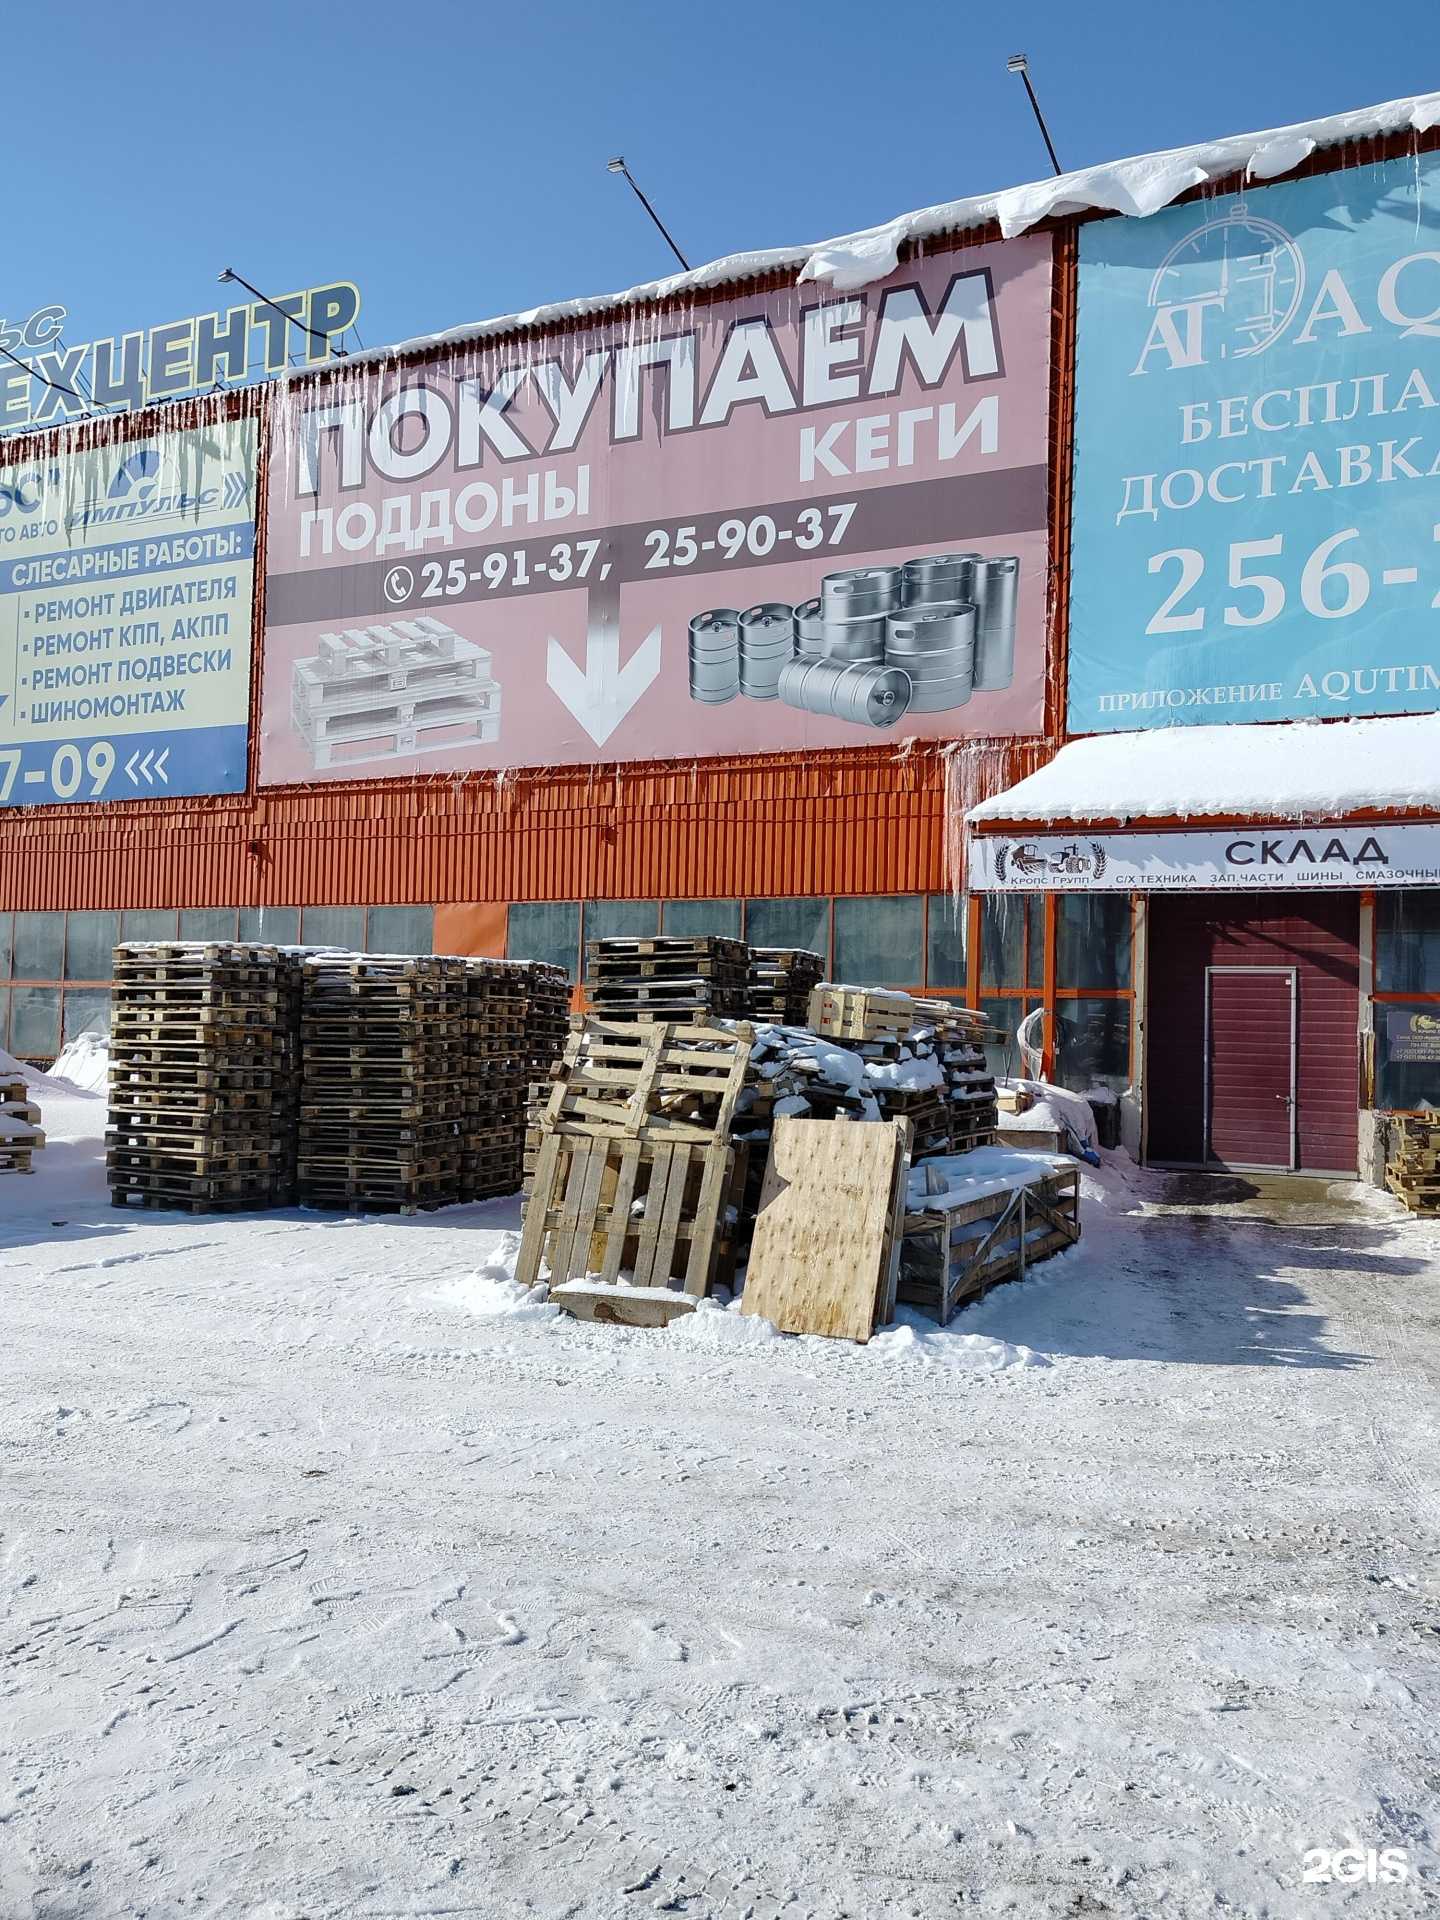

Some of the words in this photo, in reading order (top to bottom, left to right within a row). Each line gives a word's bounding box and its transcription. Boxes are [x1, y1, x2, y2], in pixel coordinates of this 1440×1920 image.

[0, 281, 361, 430] ЕХЦЕНТР
[294, 267, 1006, 497] ПОКУПАЕМ
[1179, 368, 1439, 445] БЕСПЛА
[799, 395, 999, 482] КЕГИ
[19, 519, 58, 541] АВТО
[300, 464, 590, 557] ПОДДОНЫ
[12, 545, 139, 586] СЛЕСАРНЫЕ
[145, 531, 242, 568] РАБОТЫ:
[421, 539, 613, 599] 25-91-37,
[644, 503, 858, 569] 25-90-37
[35, 593, 115, 623] РЕМОНТ
[119, 576, 237, 616] ДВИГАТЕЛЯ
[1144, 527, 1440, 635] 256-
[33, 628, 114, 657] РЕМОНТ
[119, 622, 165, 649] КПП,
[171, 613, 229, 641] АКПП
[32, 662, 112, 690] РЕМОНТ
[117, 649, 232, 682] ПОДВЕСКИ
[1098, 682, 1282, 712] ПРИЛОЖЕНИЕ
[30, 689, 186, 724] ШИНОМОНТАЖ
[0, 741, 116, 800] 7-09
[1115, 874, 1136, 884] С/Х
[1139, 873, 1197, 884] ТЕХНИКА
[1209, 873, 1284, 883] ЗАП.ЧАСТИ
[1297, 871, 1343, 881] ШИНЫ
[1355, 868, 1440, 880] СМАЗОЧНЫ
[1225, 837, 1389, 865] СКЛАД
